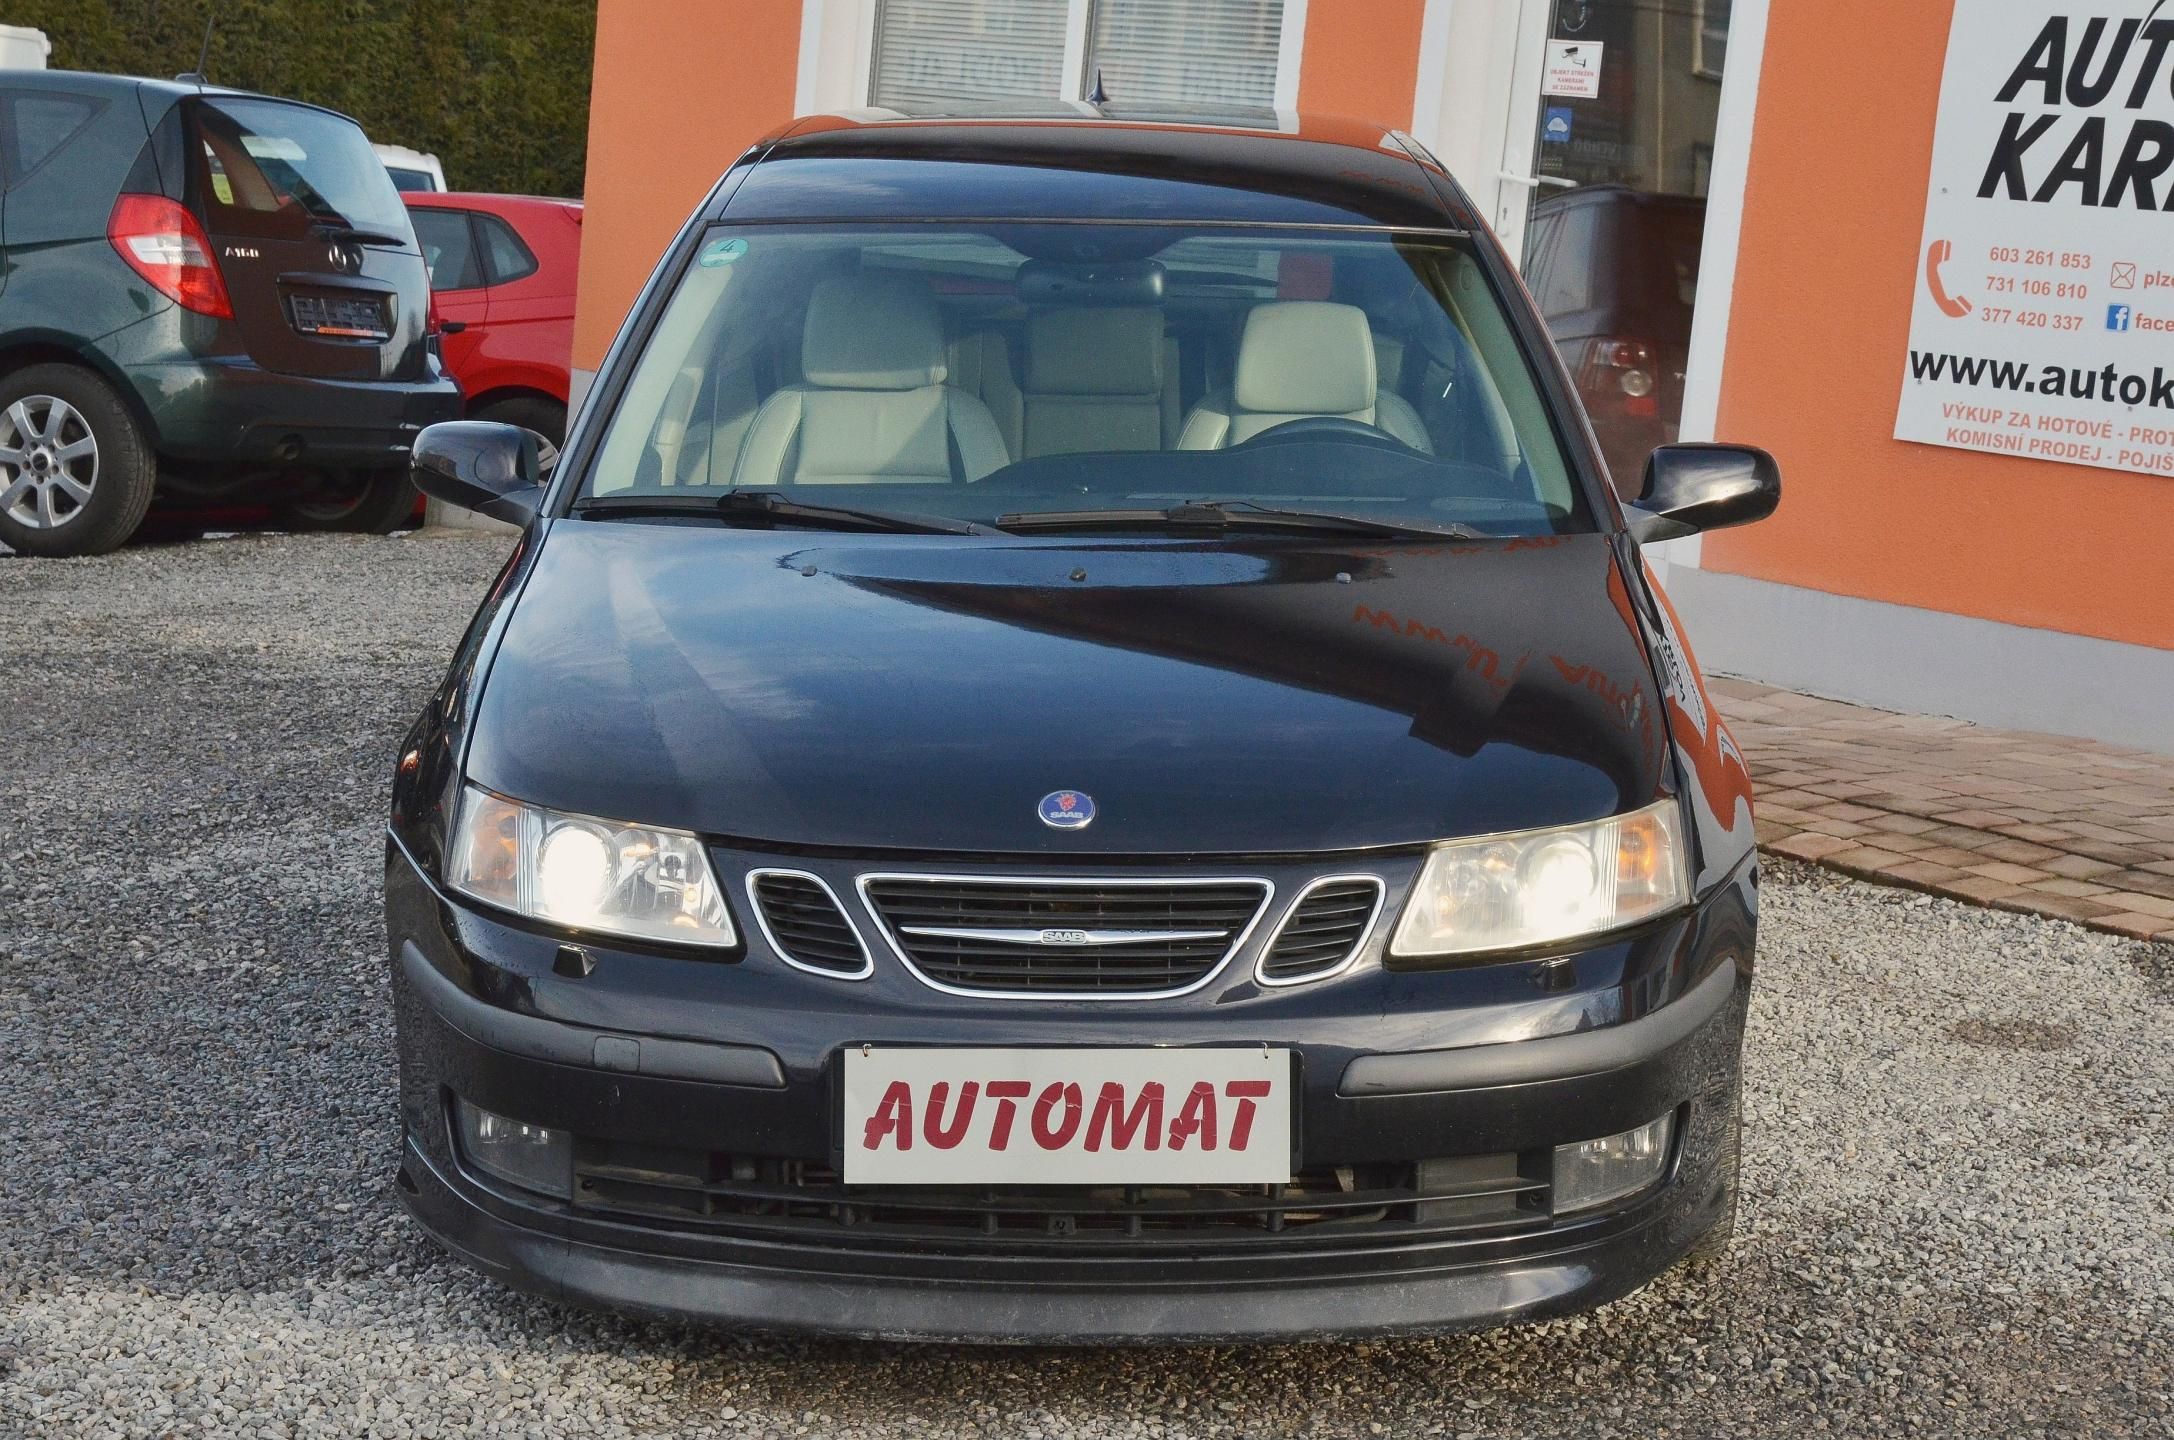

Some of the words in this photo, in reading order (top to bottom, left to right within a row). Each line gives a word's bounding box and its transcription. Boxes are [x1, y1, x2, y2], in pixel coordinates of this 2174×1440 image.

[1993, 16, 2174, 109] AUT
[1976, 112, 2174, 212] KAR
[1990, 246, 2020, 263] 603
[2025, 249, 2054, 266] 261
[2060, 253, 2091, 269] 853
[1986, 275, 2015, 292] 731
[2021, 279, 2051, 296] 106
[2056, 282, 2087, 299] 810
[1981, 306, 2012, 324] 377
[2016, 311, 2047, 328] 420
[2052, 314, 2083, 331] 337
[1942, 401, 2003, 424] VÝKUP
[2007, 411, 2031, 429] ZA
[2037, 415, 2113, 439] HOTOVÉ
[1946, 427, 2024, 451] KOMISNÍ
[2028, 438, 2102, 462] PRODEJ
[2118, 449, 2174, 471] POJIŠ
[1049, 811, 1084, 819] SAAB
[1043, 931, 1085, 942] SAAB
[862, 1080, 1272, 1153] AUTOMAT
